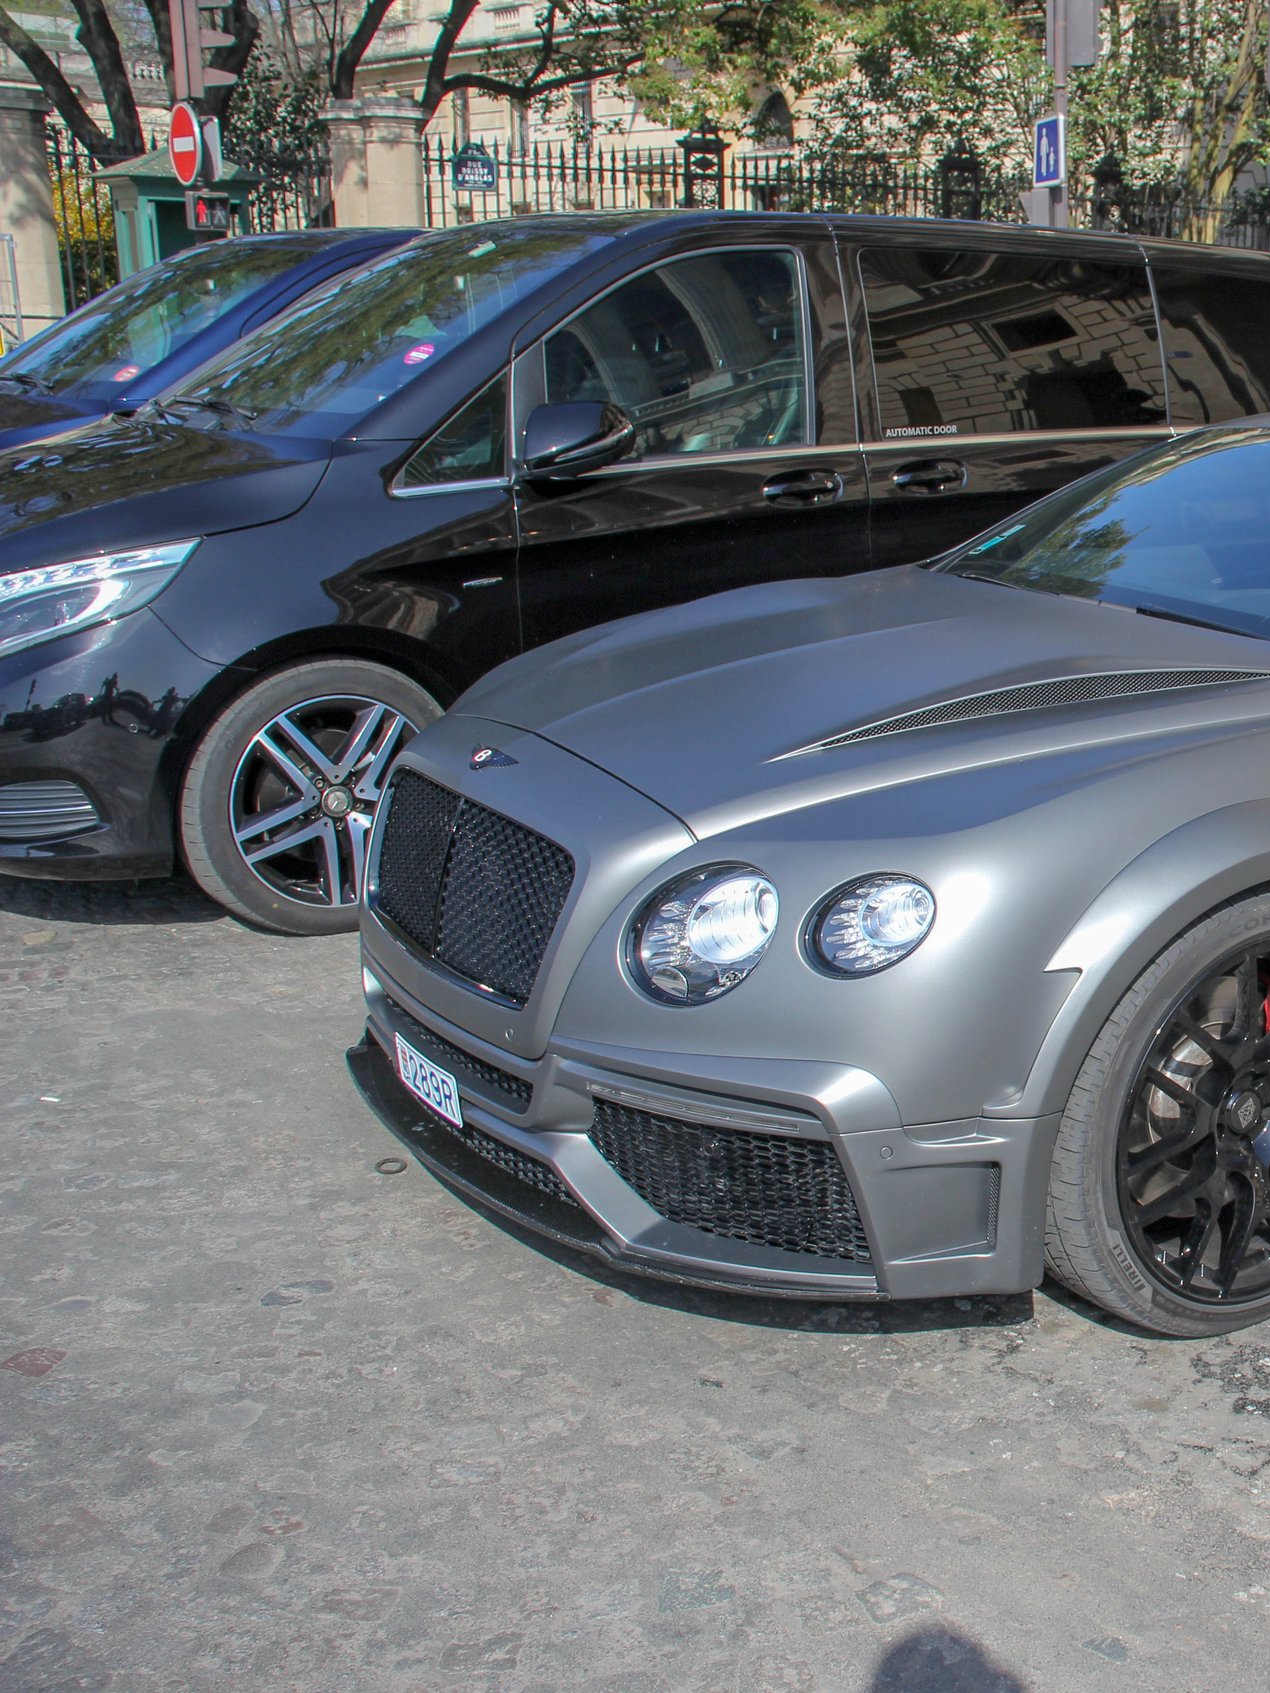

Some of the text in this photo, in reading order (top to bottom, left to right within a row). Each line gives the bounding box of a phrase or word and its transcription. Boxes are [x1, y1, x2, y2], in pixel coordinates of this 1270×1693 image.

[886, 425, 958, 437] AUTOMATIC DOOR
[409, 1053, 457, 1118] 289R
